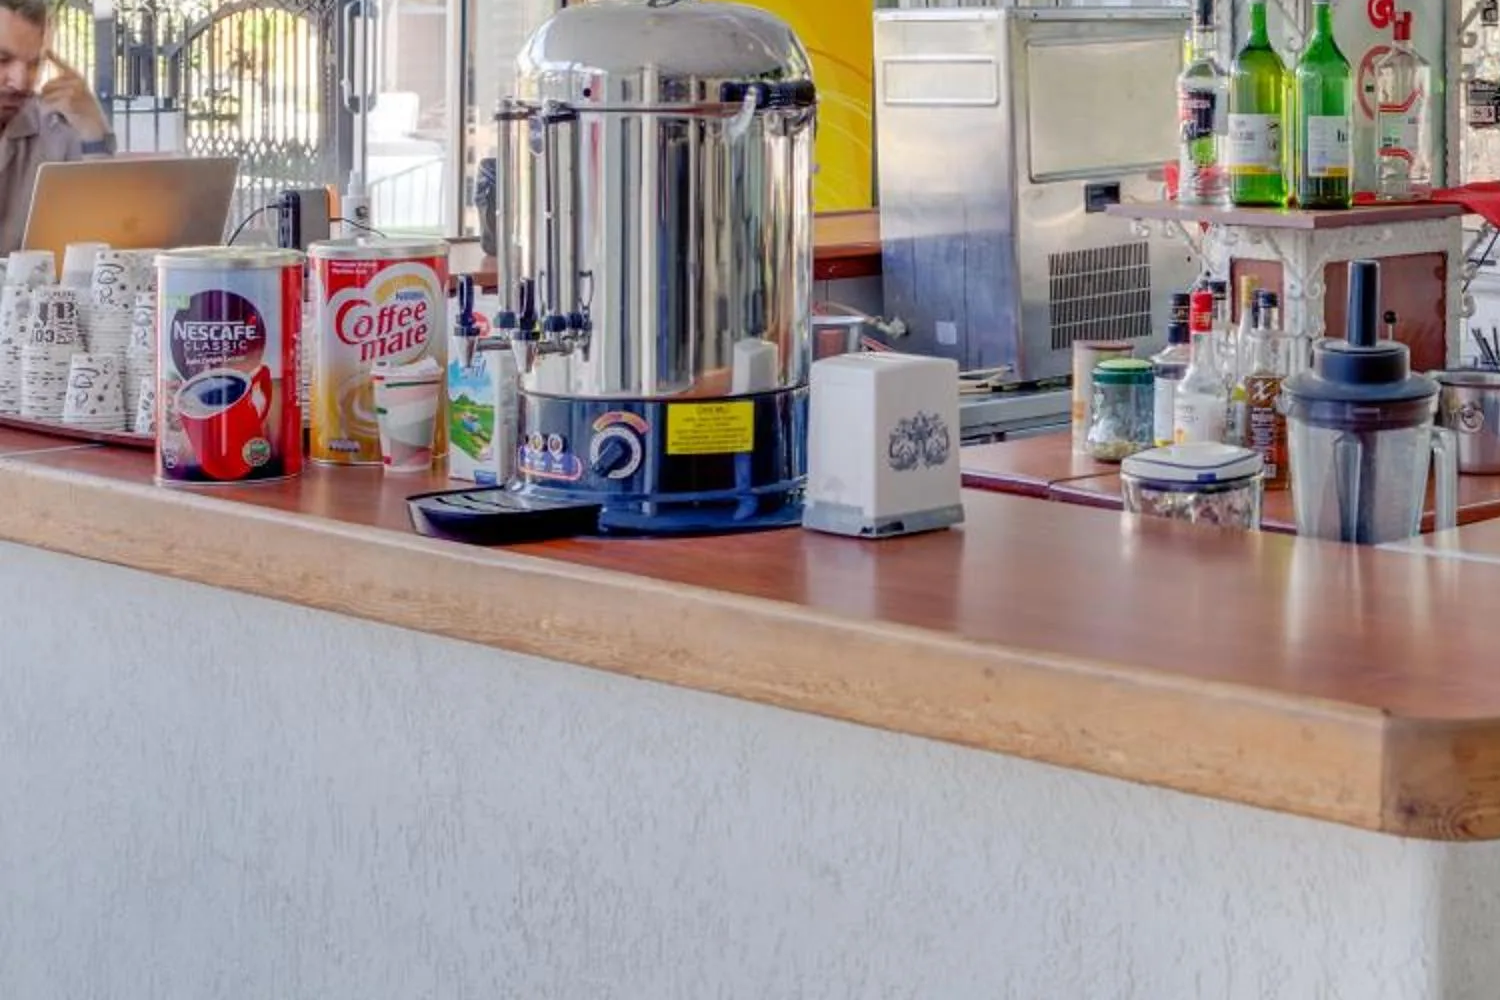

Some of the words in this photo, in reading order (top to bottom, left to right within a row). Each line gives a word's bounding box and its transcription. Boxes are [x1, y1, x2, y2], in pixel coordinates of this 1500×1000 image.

[335, 299, 427, 345] Coffee
[183, 340, 249, 352] CLASSIC
[360, 324, 427, 362] mate
